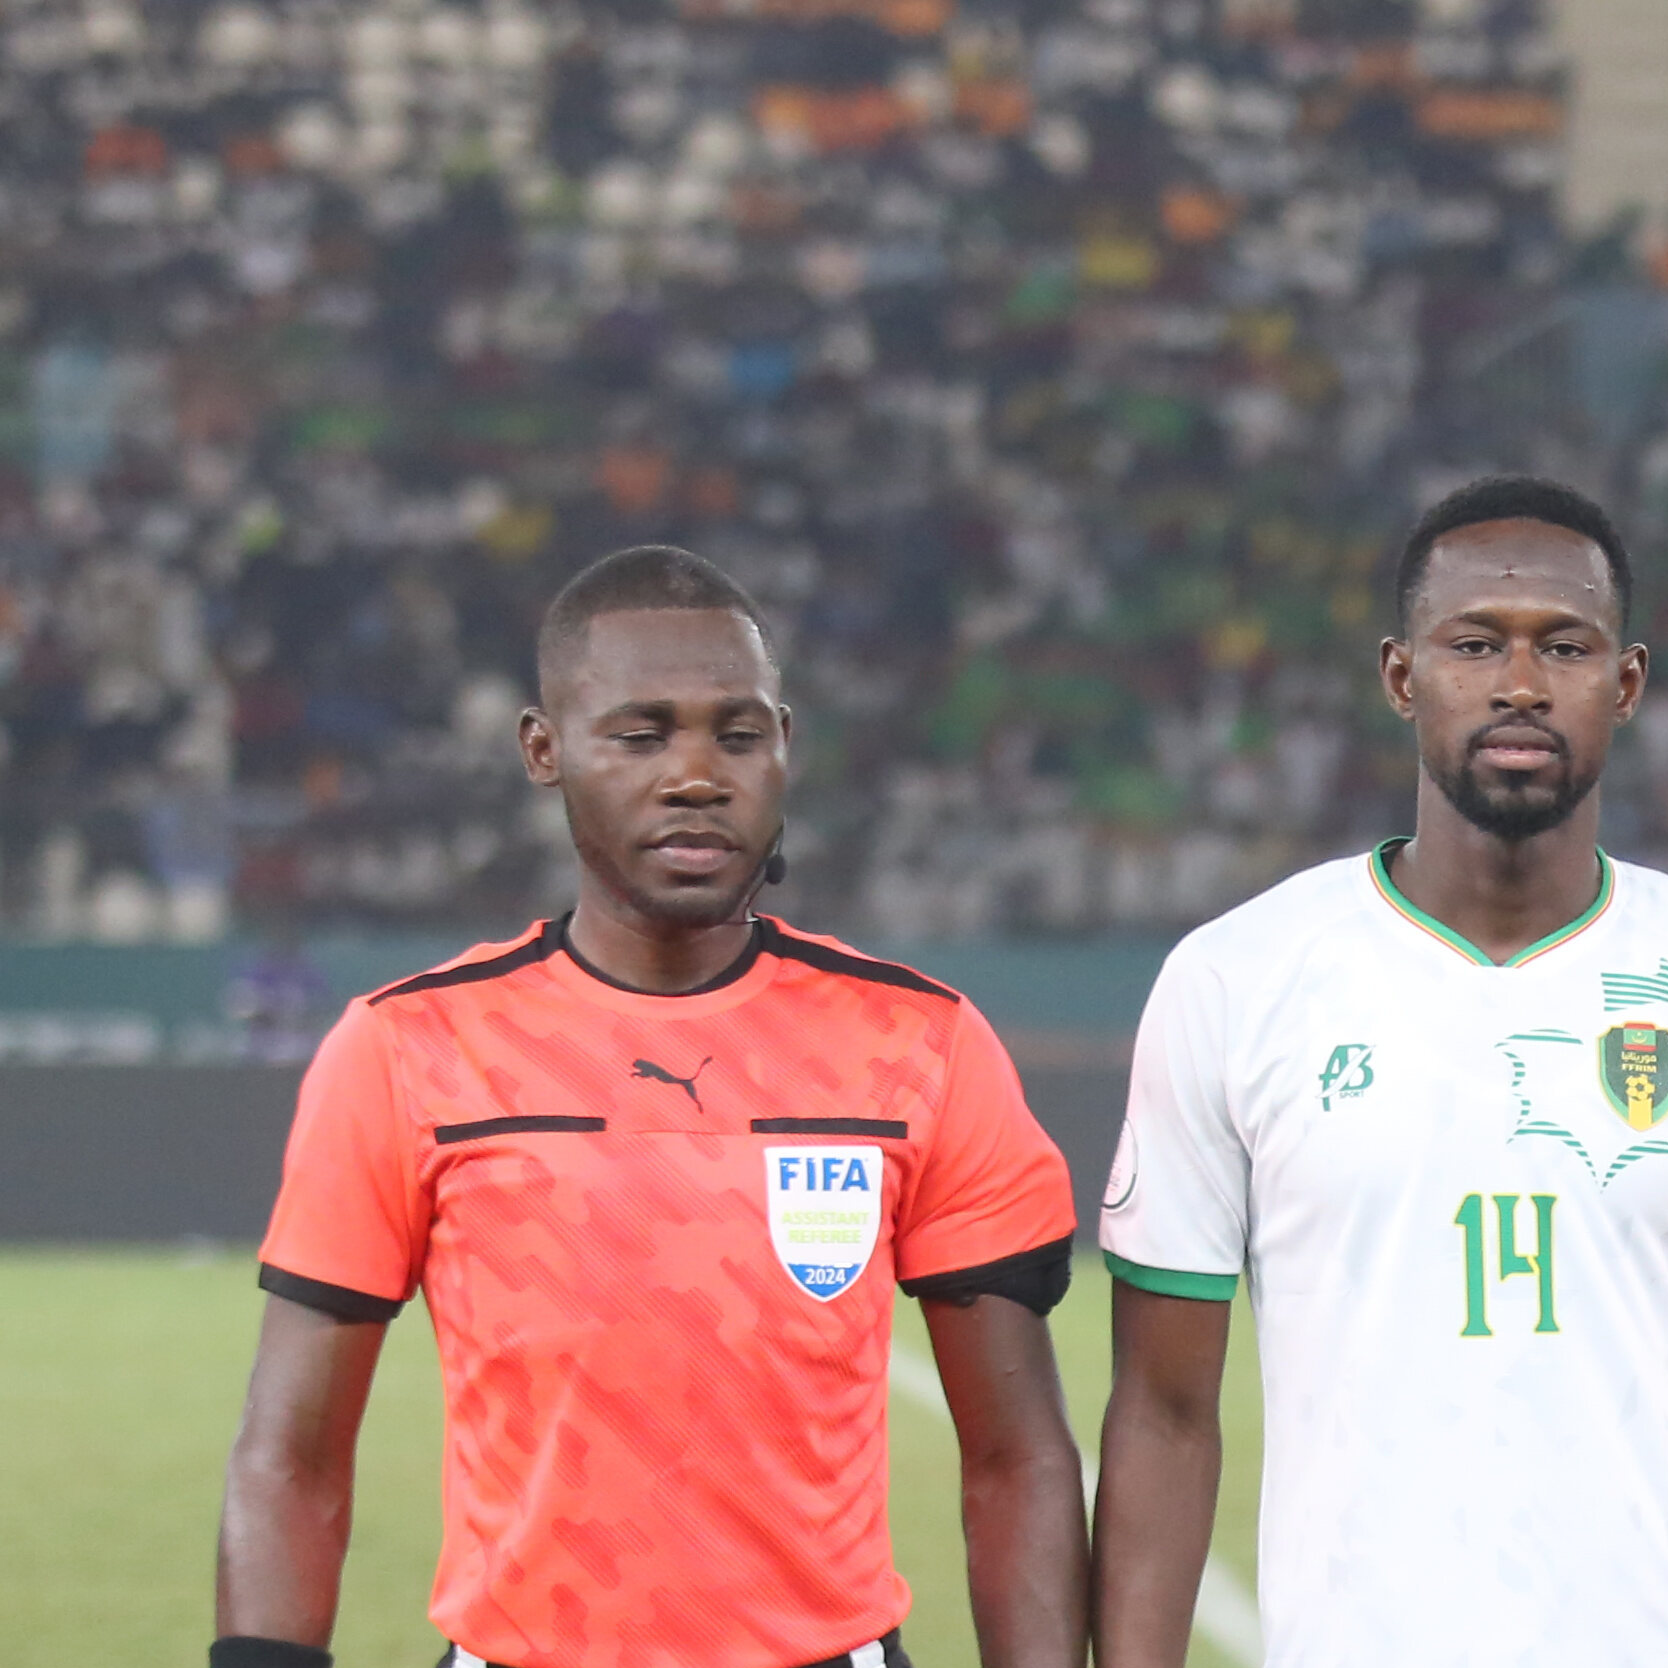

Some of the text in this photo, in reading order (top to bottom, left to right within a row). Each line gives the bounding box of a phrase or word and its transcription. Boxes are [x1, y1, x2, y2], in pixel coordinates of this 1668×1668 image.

[778, 1157, 871, 1191] FIFA
[781, 1211, 870, 1225] ASSISTANT
[788, 1228, 862, 1243] REFEREE
[1453, 1191, 1561, 1338] 14
[804, 1268, 847, 1285] 2024
